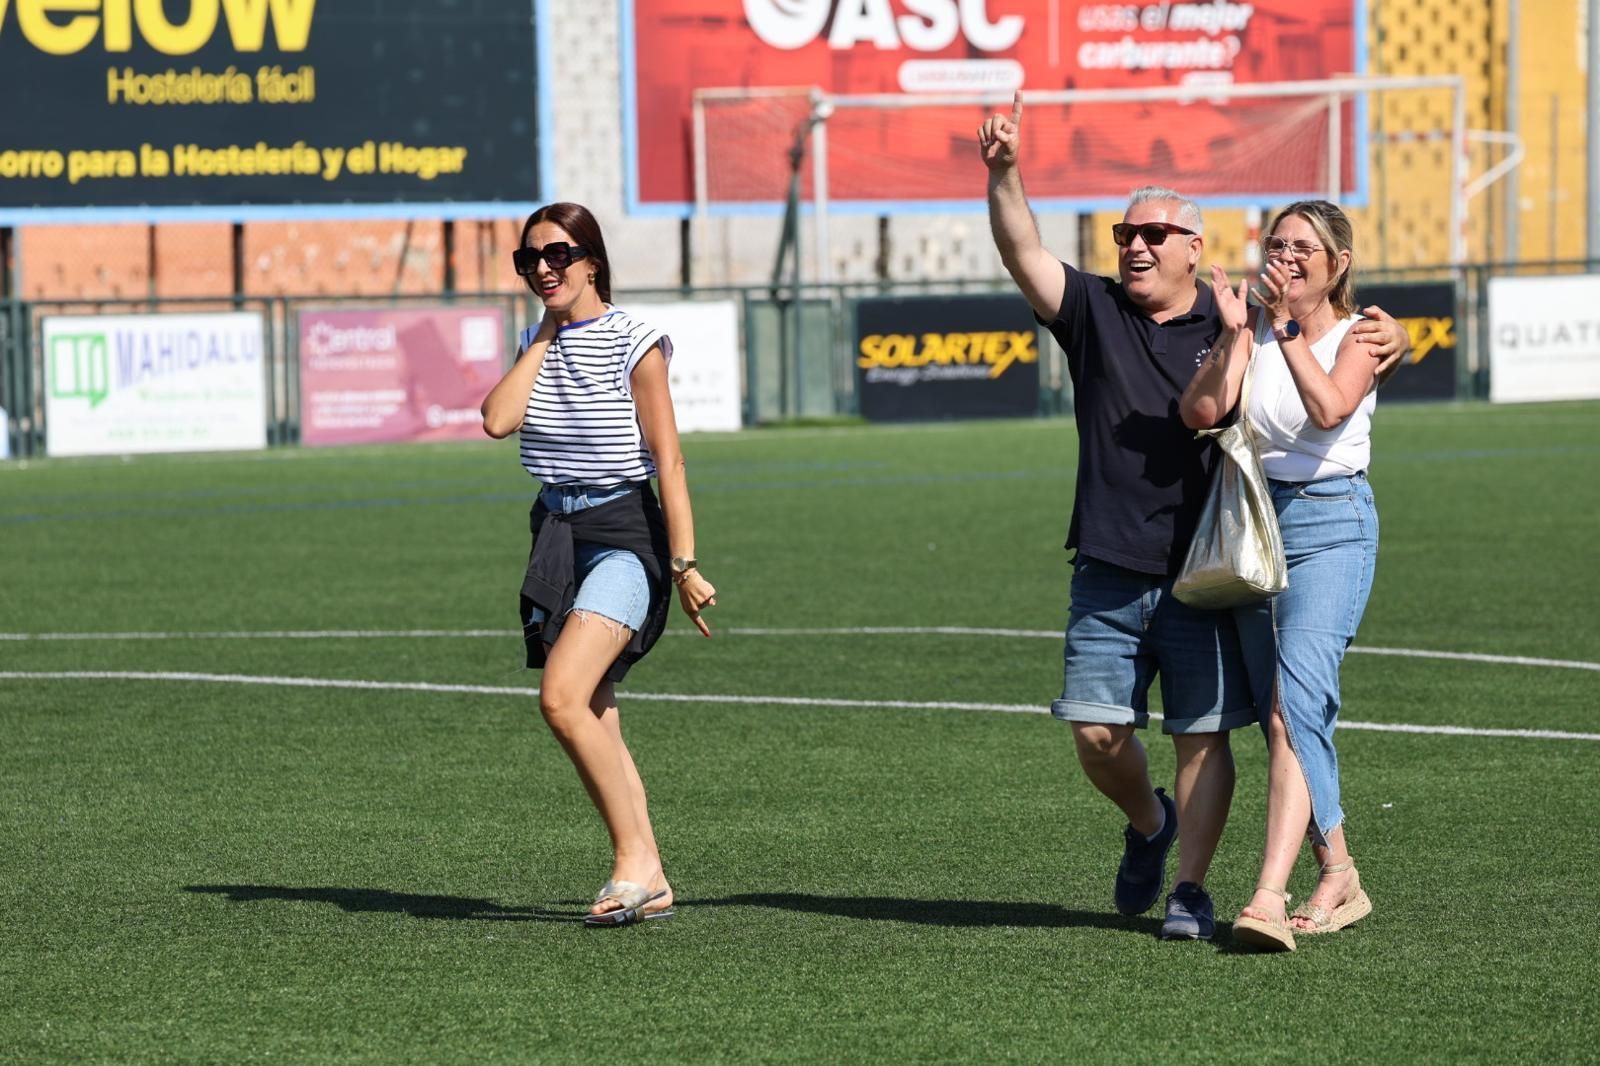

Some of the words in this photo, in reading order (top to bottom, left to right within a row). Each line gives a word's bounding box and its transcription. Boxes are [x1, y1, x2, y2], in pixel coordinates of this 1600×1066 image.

[1169, 0, 1255, 35] mejor
[1077, 35, 1241, 69] carburante?
[107, 65, 252, 104] Hostelería
[257, 65, 316, 103] fácil
[68, 150, 136, 185] para
[140, 143, 170, 177] la
[173, 140, 321, 177] Hostelería
[322, 147, 345, 181] y
[346, 140, 376, 175] el
[379, 141, 468, 180] Hogar
[857, 331, 1039, 379] SOLARTEX
